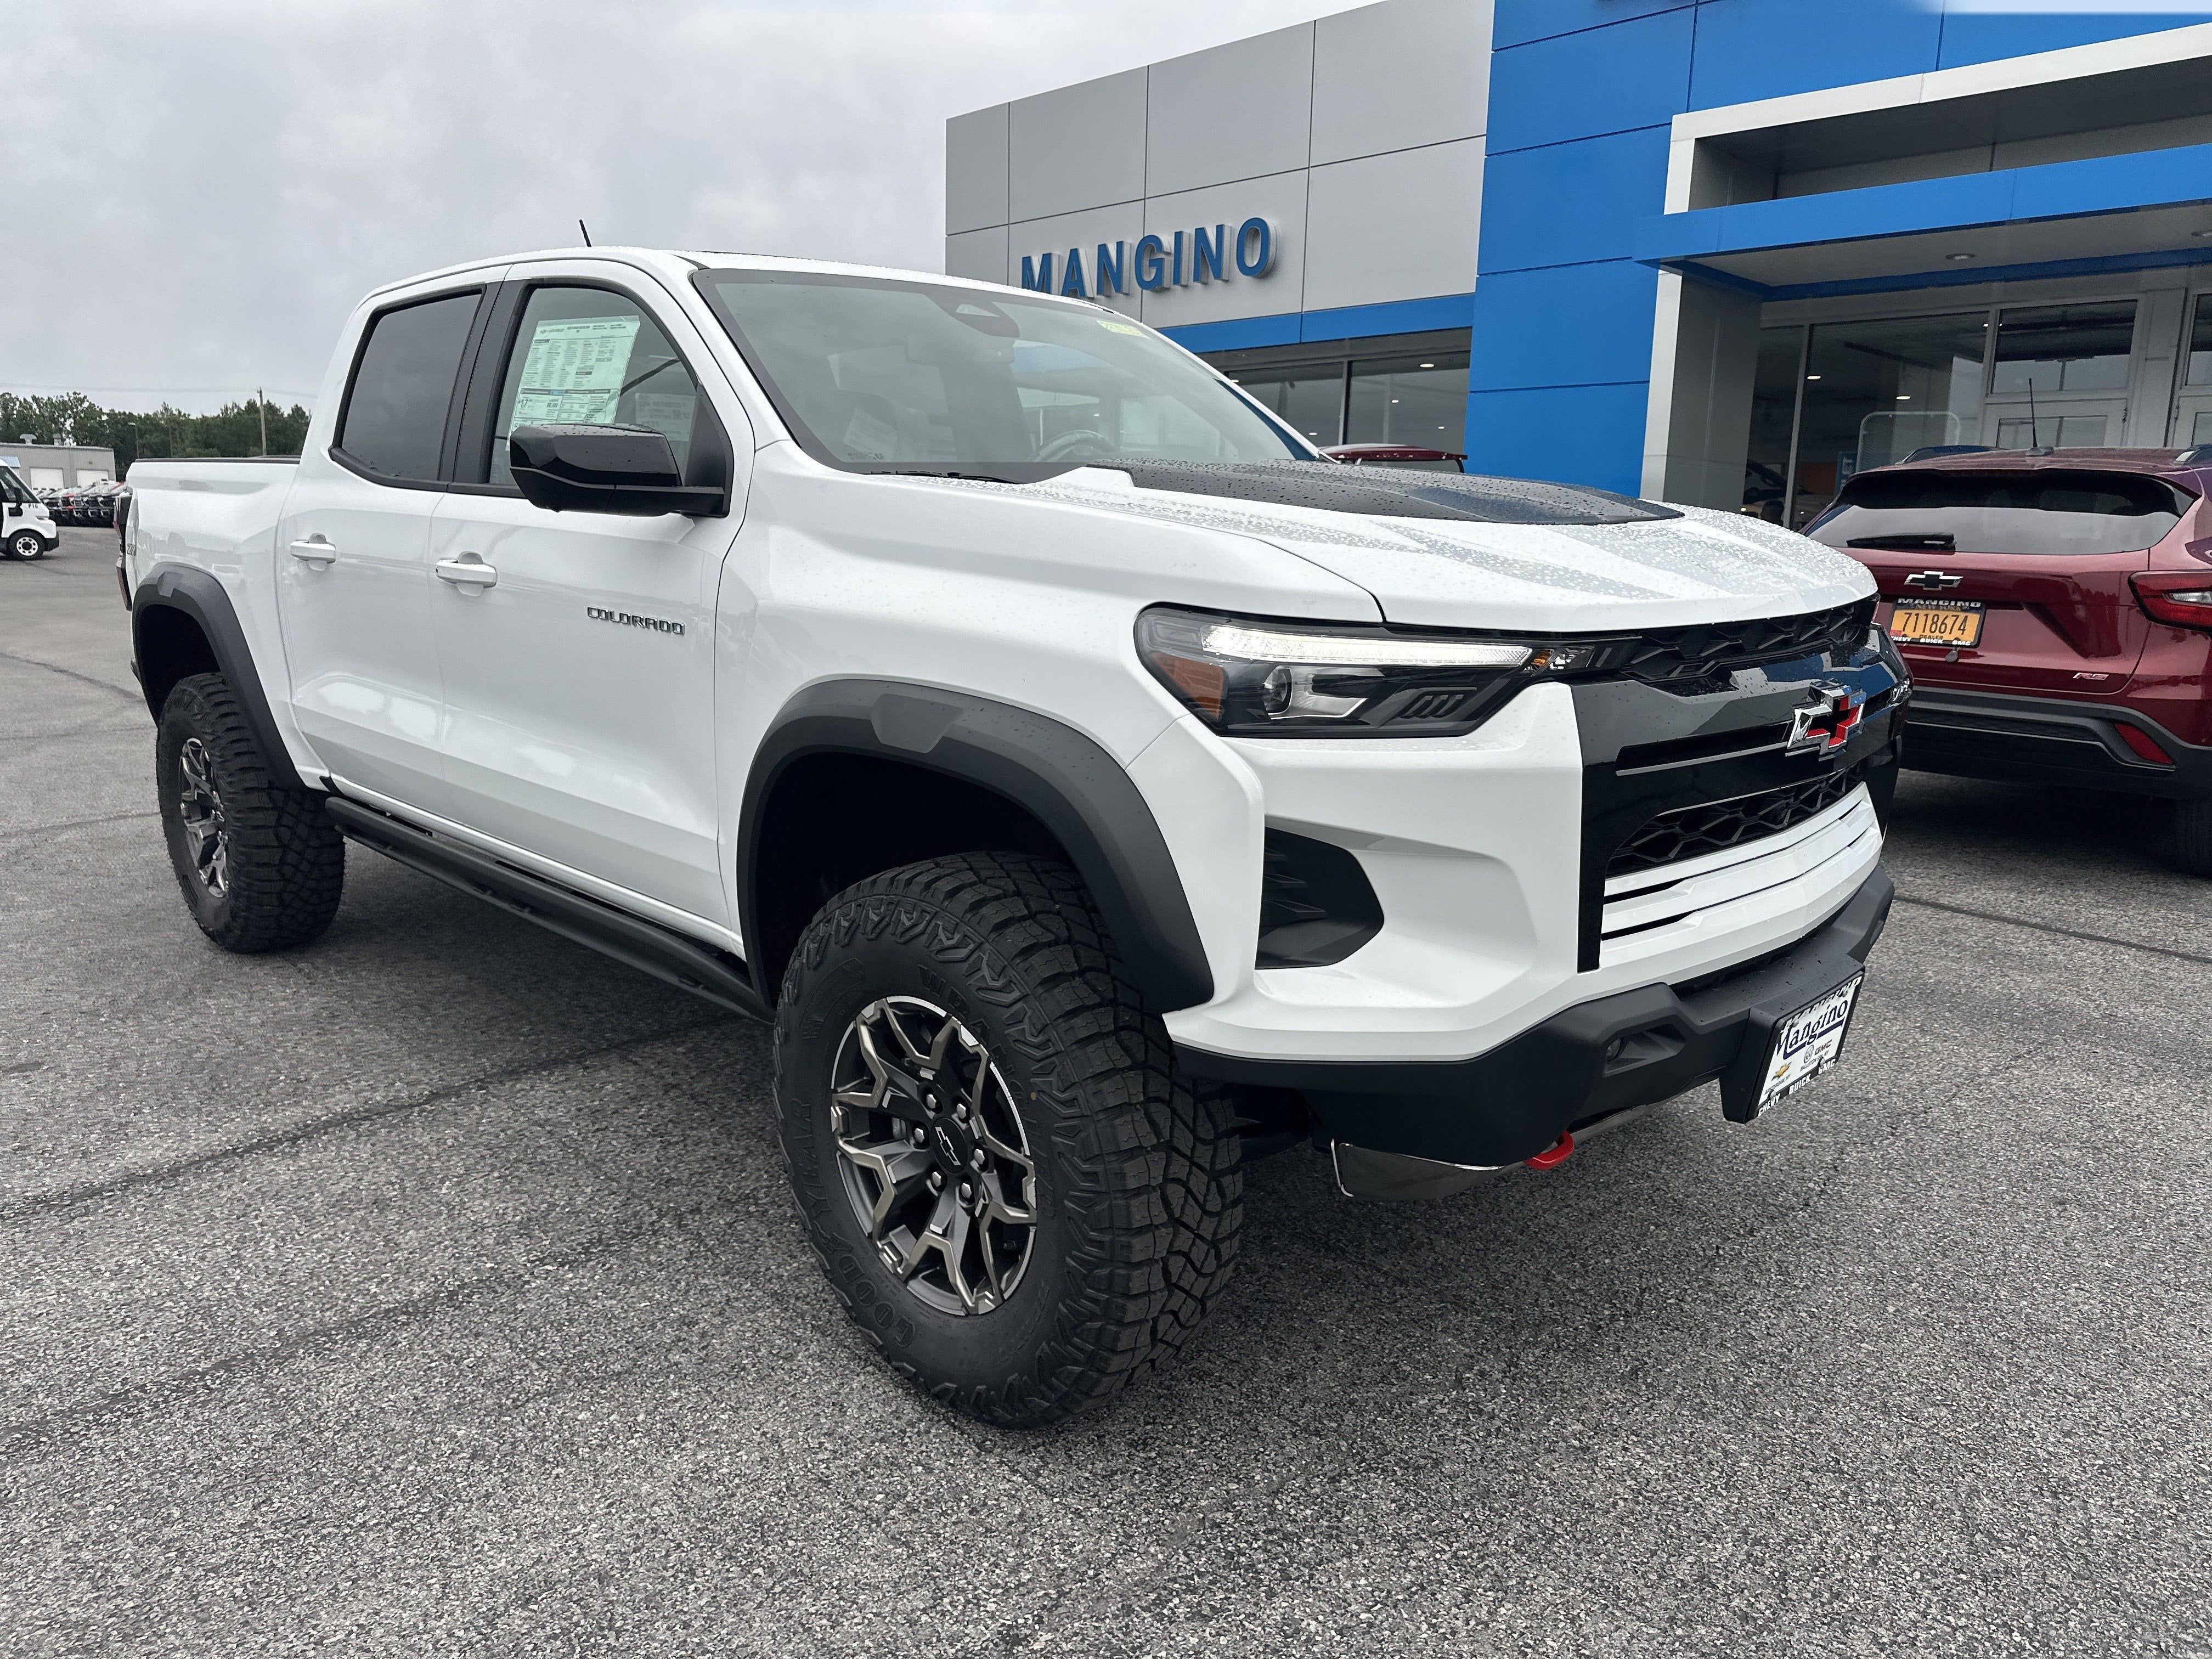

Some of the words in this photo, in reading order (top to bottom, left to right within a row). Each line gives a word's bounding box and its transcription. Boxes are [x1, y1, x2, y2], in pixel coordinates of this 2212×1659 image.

[1021, 217, 1277, 298] MANGINO
[1898, 598, 1982, 607] MANGINO
[588, 607, 685, 635] COLORADO
[1903, 612, 1968, 635] 7118674
[2073, 672, 2109, 680] RS
[1776, 1000, 1848, 1060] Mangino
[1814, 1039, 1832, 1056] GMC
[1758, 1093, 1781, 1117] CHEVY
[1789, 1073, 1812, 1095] BUICK
[790, 1098, 916, 1347] GOODYEAR
